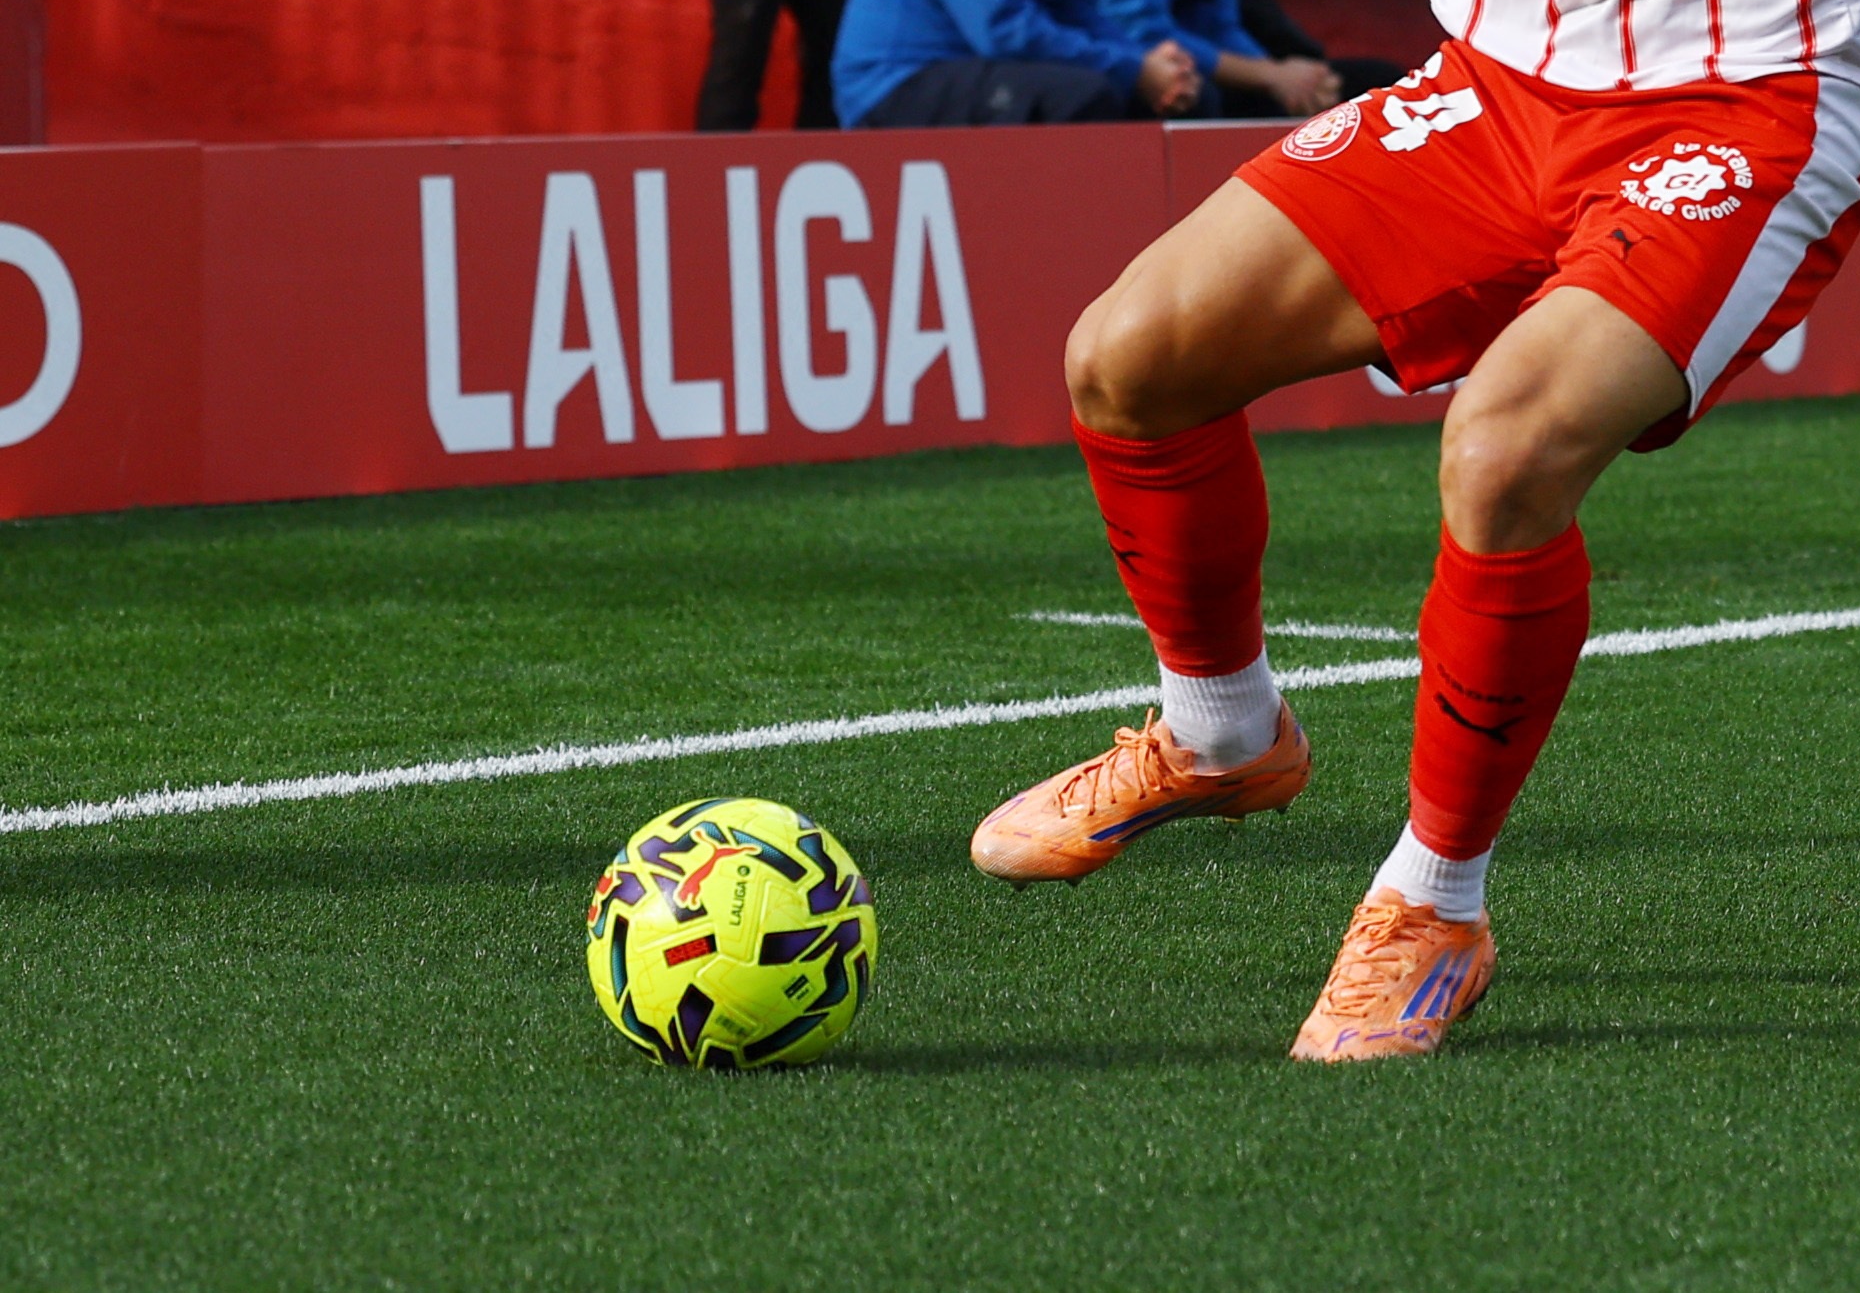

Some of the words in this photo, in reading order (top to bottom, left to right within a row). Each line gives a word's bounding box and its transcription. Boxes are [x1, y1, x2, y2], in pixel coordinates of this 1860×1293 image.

[1649, 199, 1676, 215] de
[1681, 195, 1741, 221] Girona
[419, 160, 985, 454] LALIGA
[730, 881, 748, 927] LALIGA
